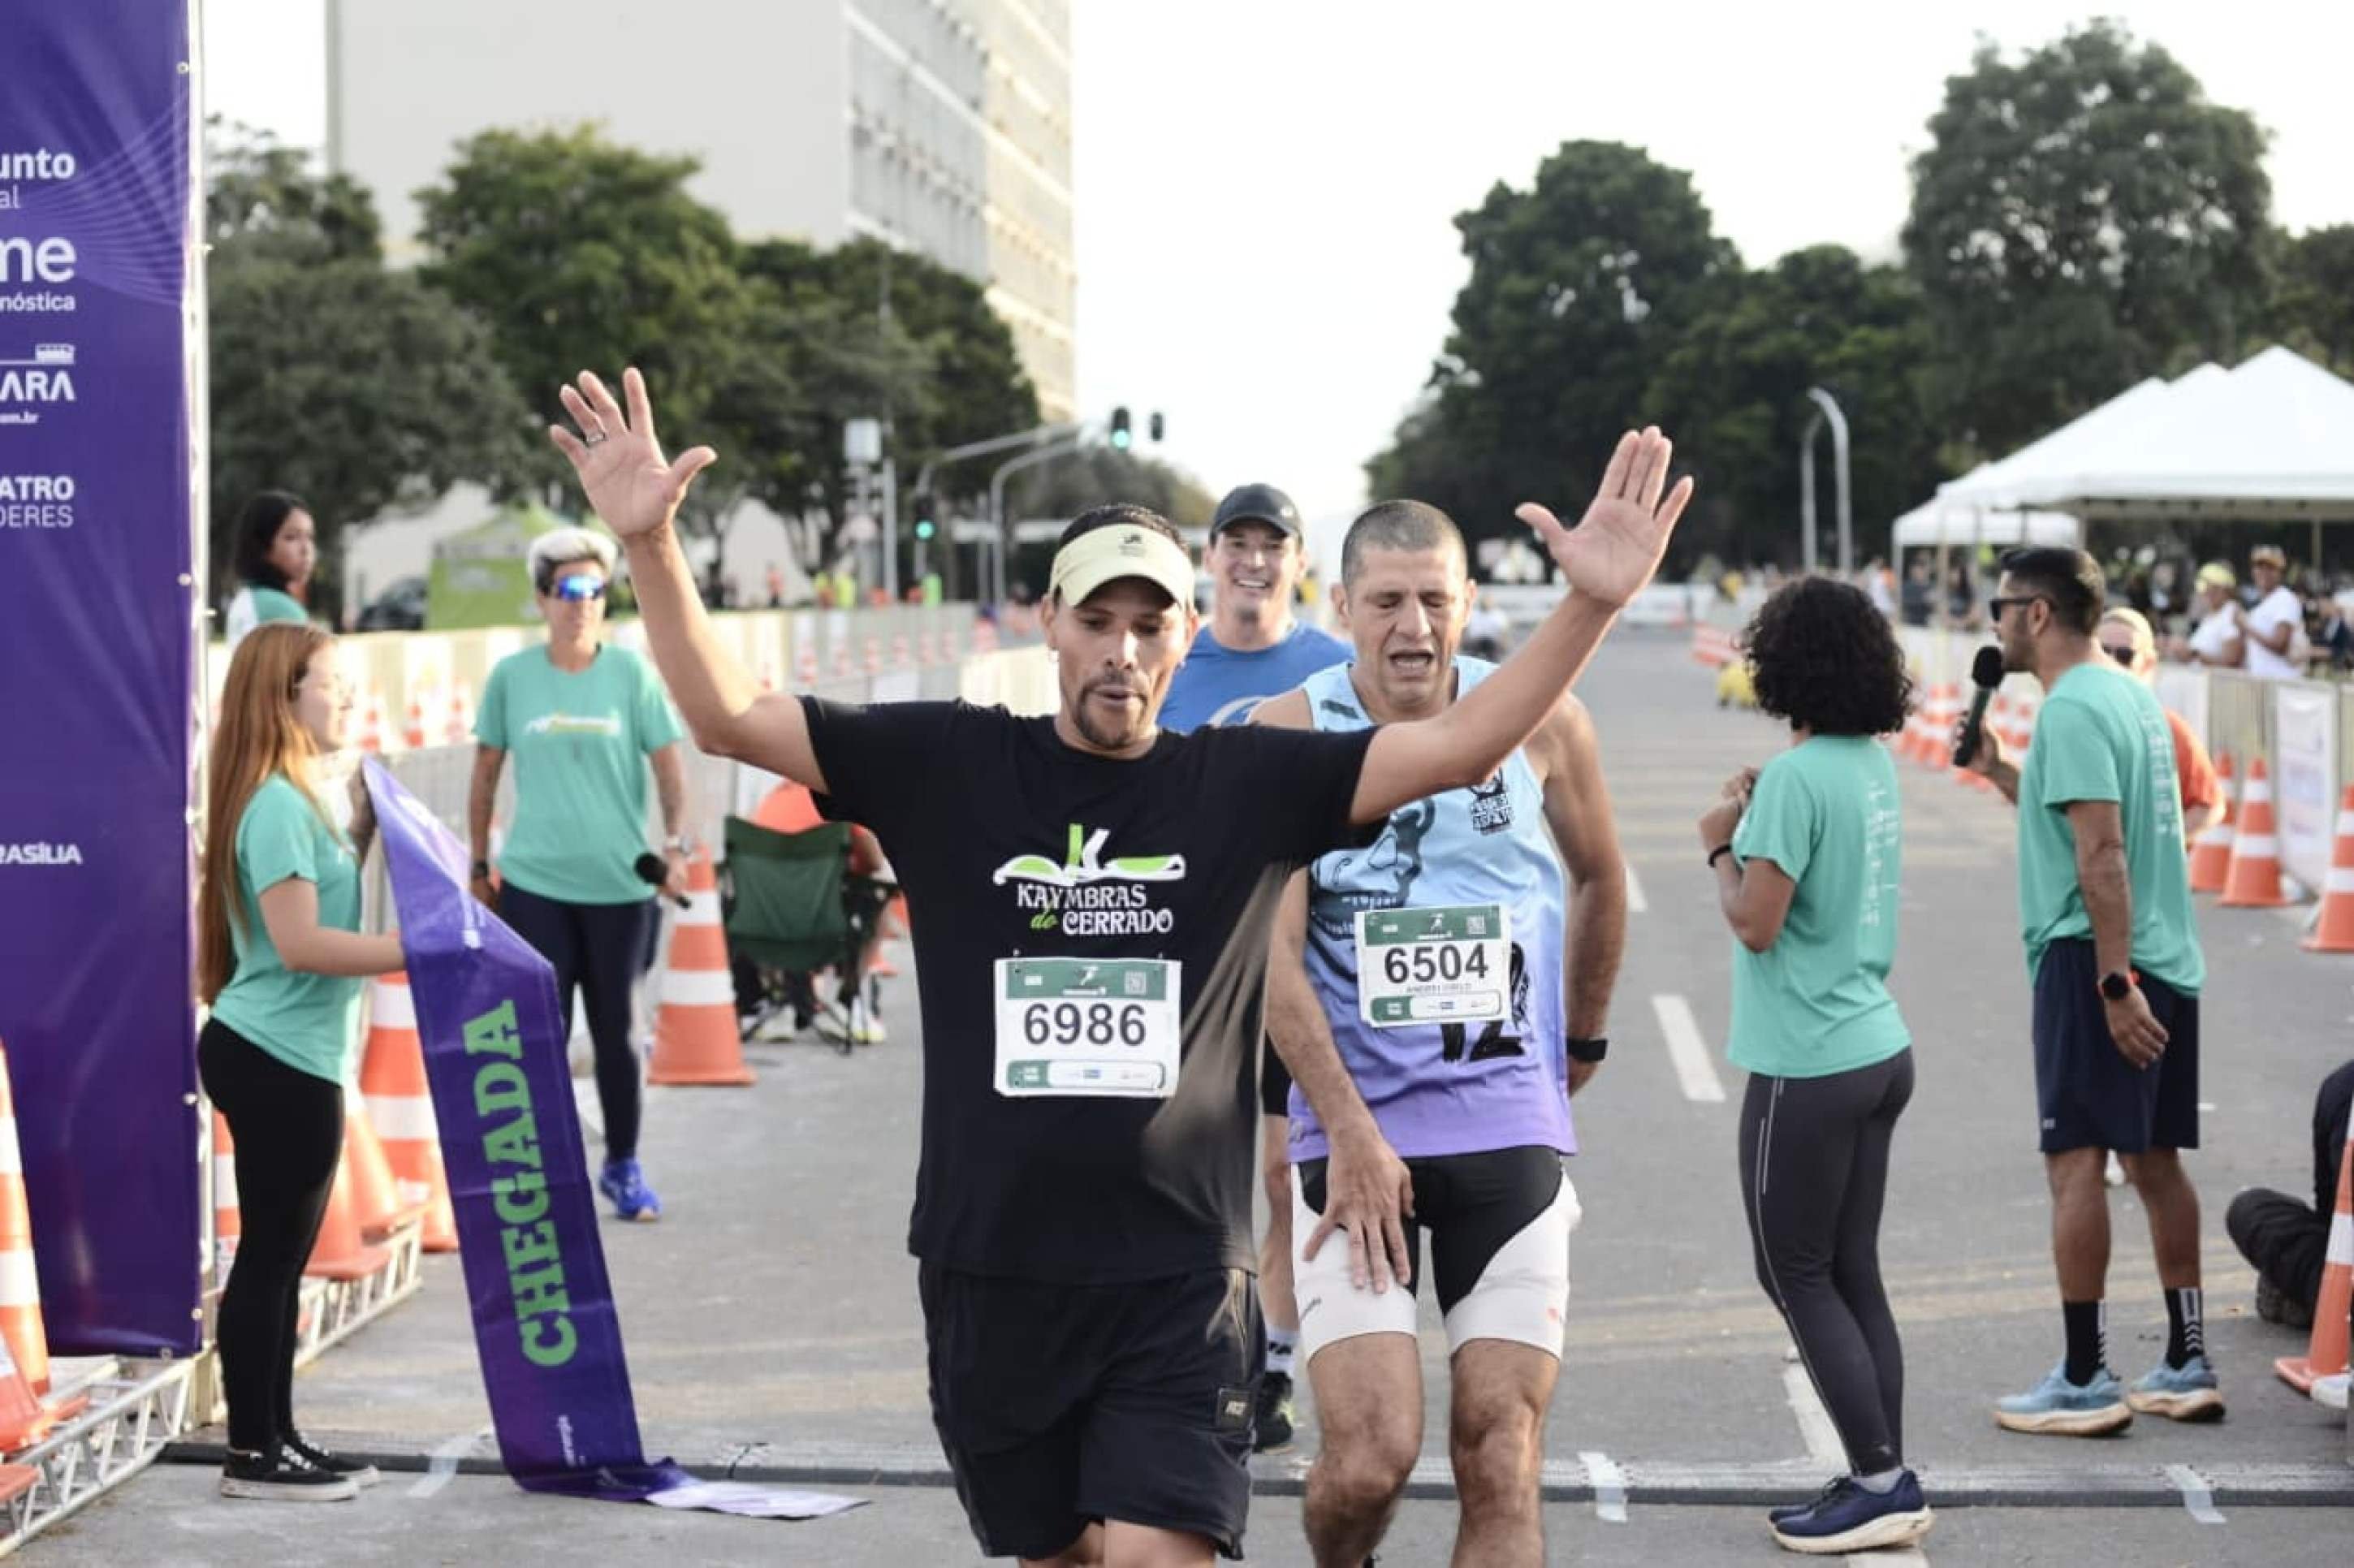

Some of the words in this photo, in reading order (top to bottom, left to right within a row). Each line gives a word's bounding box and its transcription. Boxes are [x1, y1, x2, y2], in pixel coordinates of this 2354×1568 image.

[0, 475, 75, 501] ATRO
[1061, 907, 1173, 935] CERRADO
[1384, 942, 1488, 984] 6504
[1024, 1003, 1147, 1047] 6986
[462, 999, 577, 1368] CHEGADA
